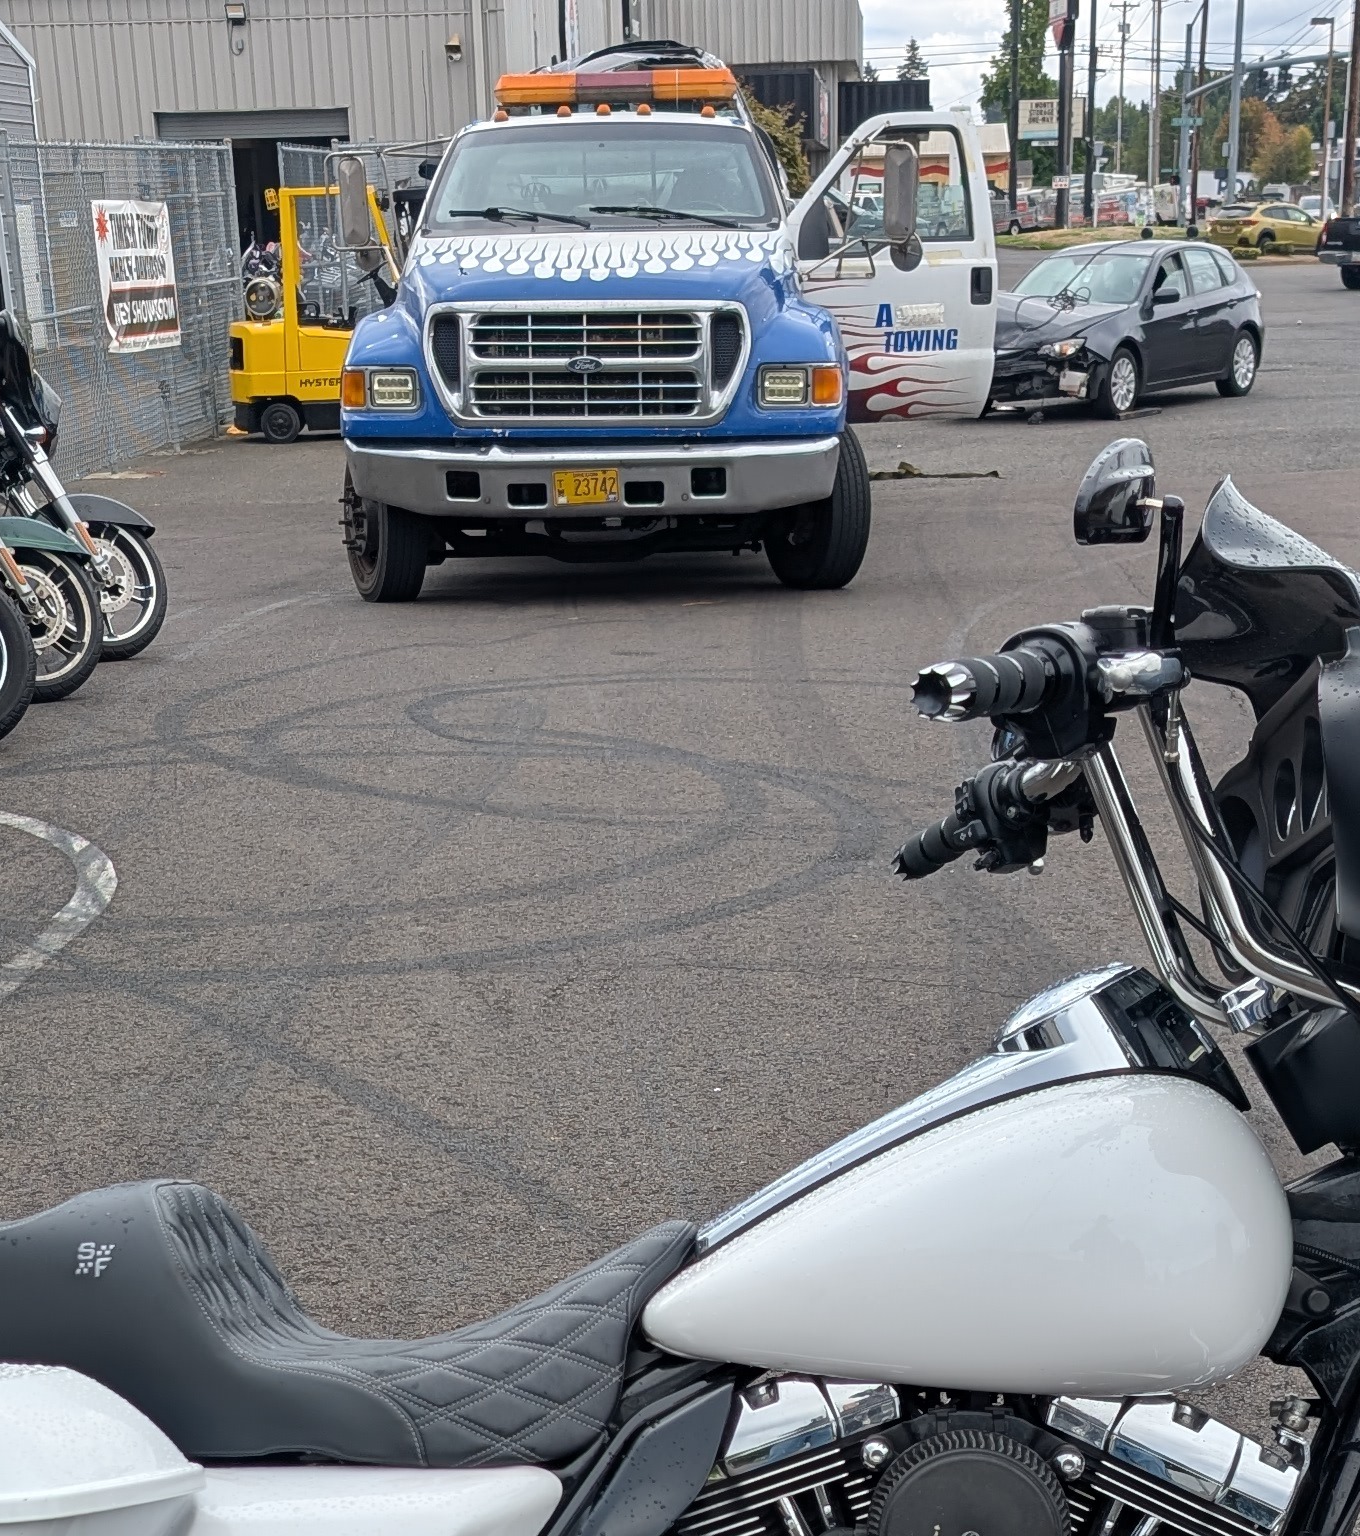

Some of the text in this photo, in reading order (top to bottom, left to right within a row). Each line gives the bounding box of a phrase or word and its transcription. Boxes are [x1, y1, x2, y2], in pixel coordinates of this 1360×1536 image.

[875, 303, 893, 328] A
[883, 329, 958, 353] TOWING
[574, 360, 596, 370] Ford
[573, 476, 617, 497] 23742
